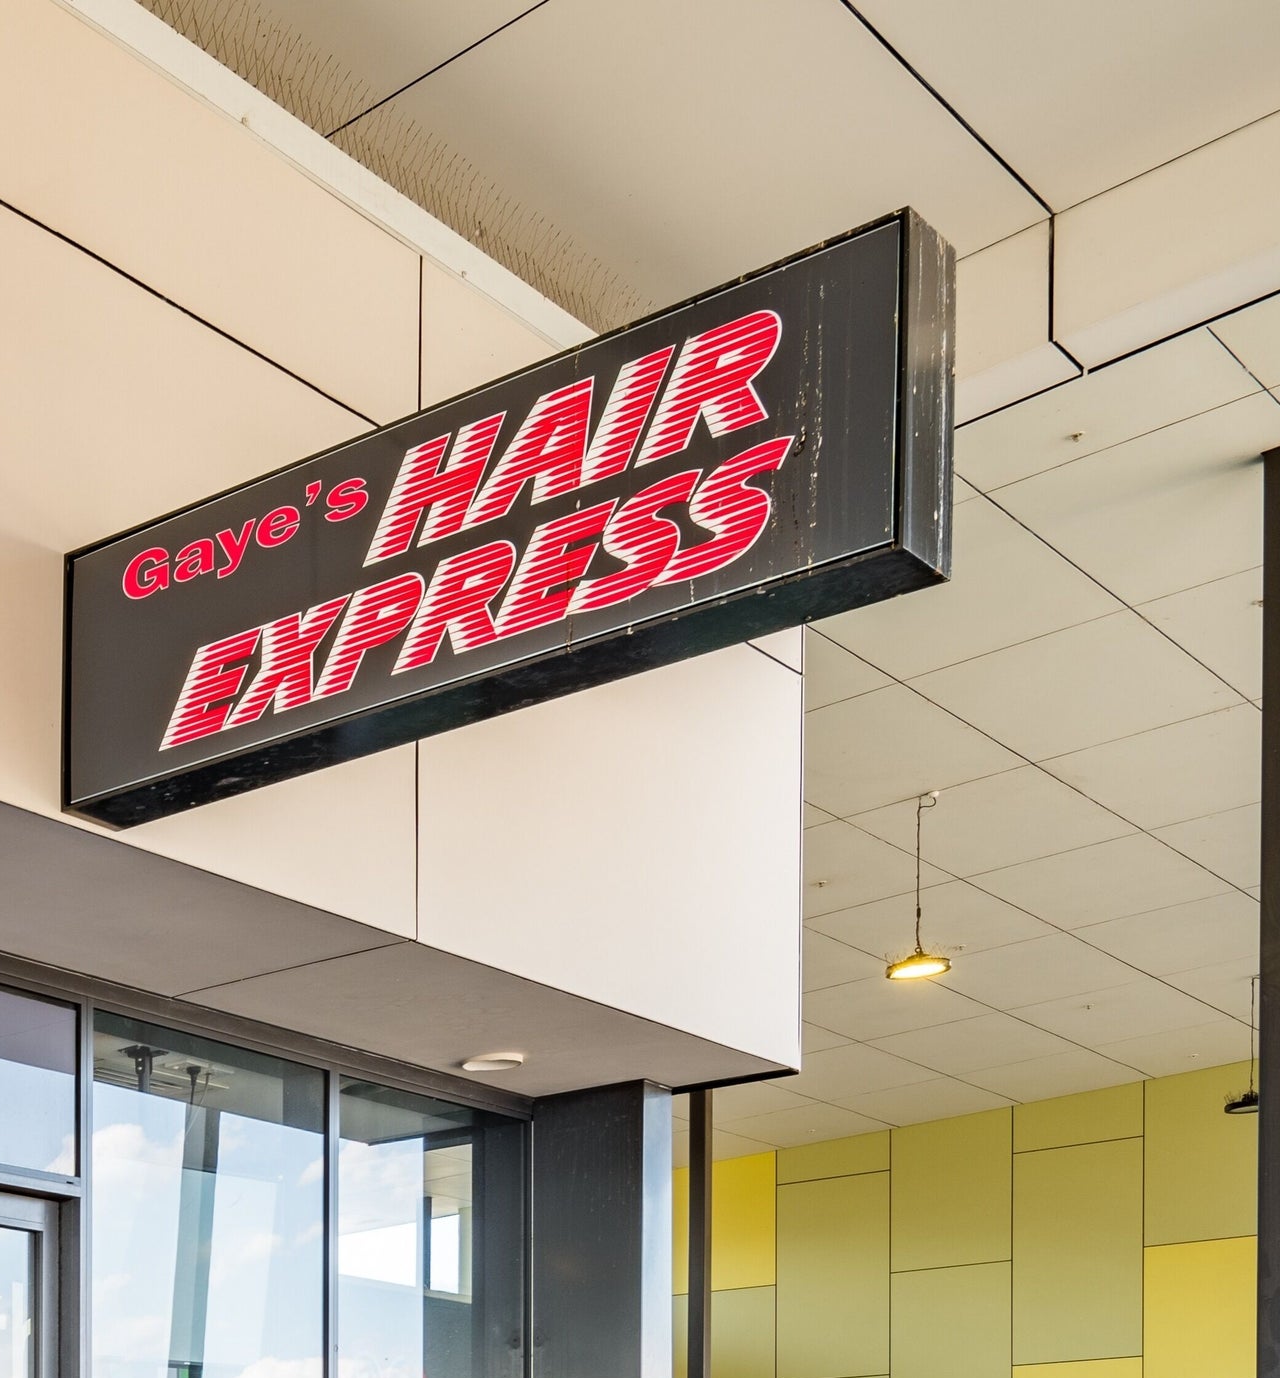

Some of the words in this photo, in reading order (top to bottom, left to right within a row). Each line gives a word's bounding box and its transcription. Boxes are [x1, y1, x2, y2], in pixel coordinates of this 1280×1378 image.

[122, 476, 369, 600] Gaye's
[364, 309, 783, 568] HAIR
[158, 435, 795, 752] EXPRESS
